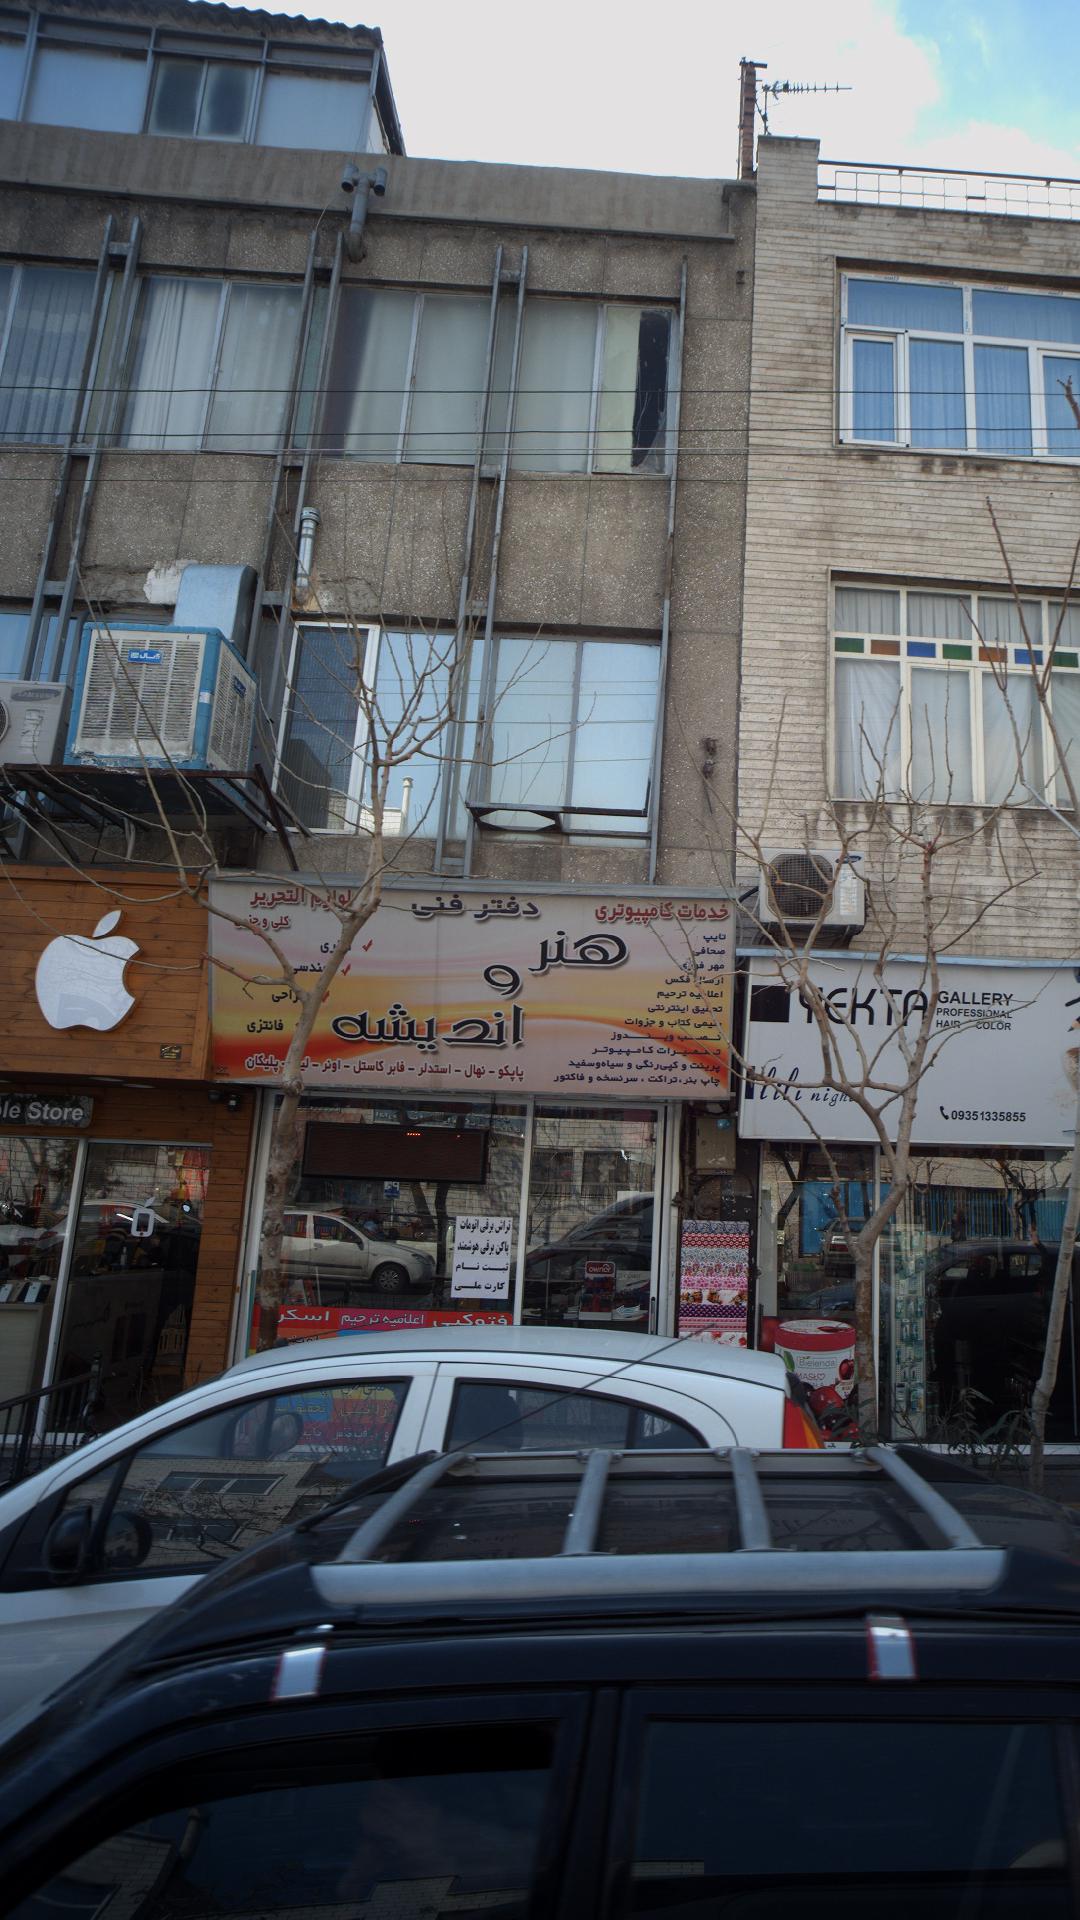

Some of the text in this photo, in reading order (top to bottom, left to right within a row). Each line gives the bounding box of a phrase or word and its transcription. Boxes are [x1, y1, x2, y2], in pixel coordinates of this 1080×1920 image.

[250, 887, 305, 906] التحریر
[411, 894, 539, 919] دفتر فنی
[595, 902, 730, 924] خدمات کامپیوتری
[262, 918, 268, 928] و
[271, 916, 289, 928] کلی
[703, 933, 727, 943] تایپ
[529, 930, 627, 972] هنر
[692, 947, 725, 956] صحافی
[708, 963, 725, 972] مهر
[484, 965, 521, 995] و
[665, 975, 690, 985] فکس
[657, 990, 723, 999] اعلایه ترحیم
[938, 991, 1014, 1006] GALLERY
[647, 1004, 689, 1014] اینترنتی
[799, 988, 928, 1025] YEKTA
[936, 1007, 1013, 1019] PROFESSIONAL
[247, 1018, 284, 1033] فانتزی
[332, 1003, 523, 1050] اندیشه
[624, 1018, 657, 1028] جزوات
[659, 1020, 665, 1028] و
[667, 1018, 691, 1028] کتاب
[936, 1019, 1012, 1031] HAIR COLOR
[592, 1046, 653, 1057] کامپیوتر
[246, 1055, 279, 1072] پلیکان
[321, 1060, 341, 1072] اونر
[353, 1060, 384, 1073] کاستل
[387, 1060, 405, 1075] فابر
[418, 1062, 451, 1076] استدلر
[627, 1062, 632, 1070] و
[681, 1063, 687, 1071] و
[689, 1061, 721, 1073] پرینت
[464, 1064, 486, 1078] نهال
[498, 1065, 524, 1082] پاپکو
[553, 1072, 585, 1083] فاکتور
[588, 1075, 593, 1083] و
[701, 1075, 721, 1087] چاپ
[28, 1101, 84, 1121] Store
[950, 1109, 1026, 1123] 09351335855
[480, 1218, 494, 1234] برقی
[495, 1219, 511, 1234] تراش
[480, 1239, 495, 1256] برقی
[495, 1241, 509, 1256] پاکن
[456, 1262, 509, 1274] ثبت نام
[454, 1281, 505, 1293] کارت ملی
[340, 1314, 380, 1326] ترحیم
[383, 1314, 424, 1327] اعلامیه
